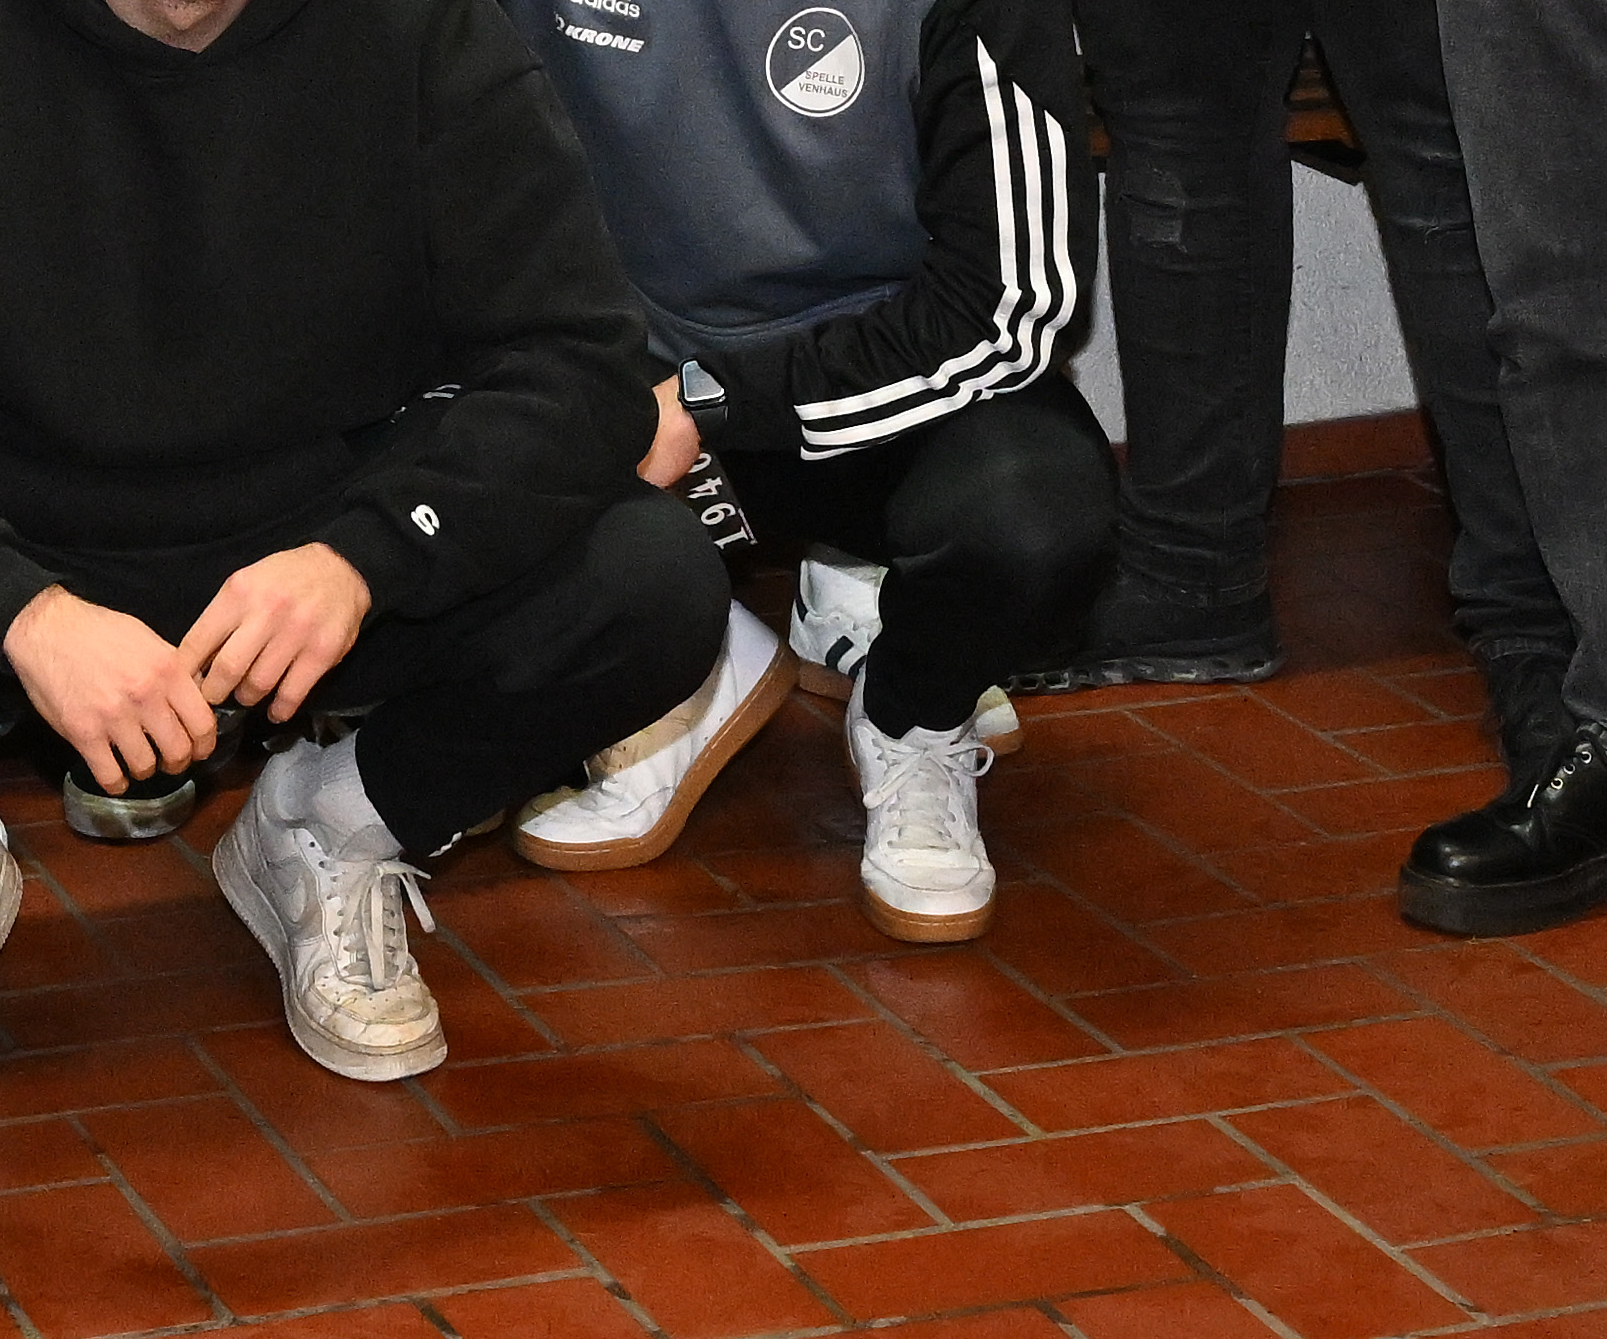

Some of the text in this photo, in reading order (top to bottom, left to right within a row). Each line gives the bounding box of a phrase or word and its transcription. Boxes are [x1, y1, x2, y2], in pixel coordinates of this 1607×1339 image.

[565, 24, 645, 53] KRONE
[787, 26, 826, 53] SC
[805, 70, 845, 86] SPELLE
[798, 82, 849, 99] VENHAUS
